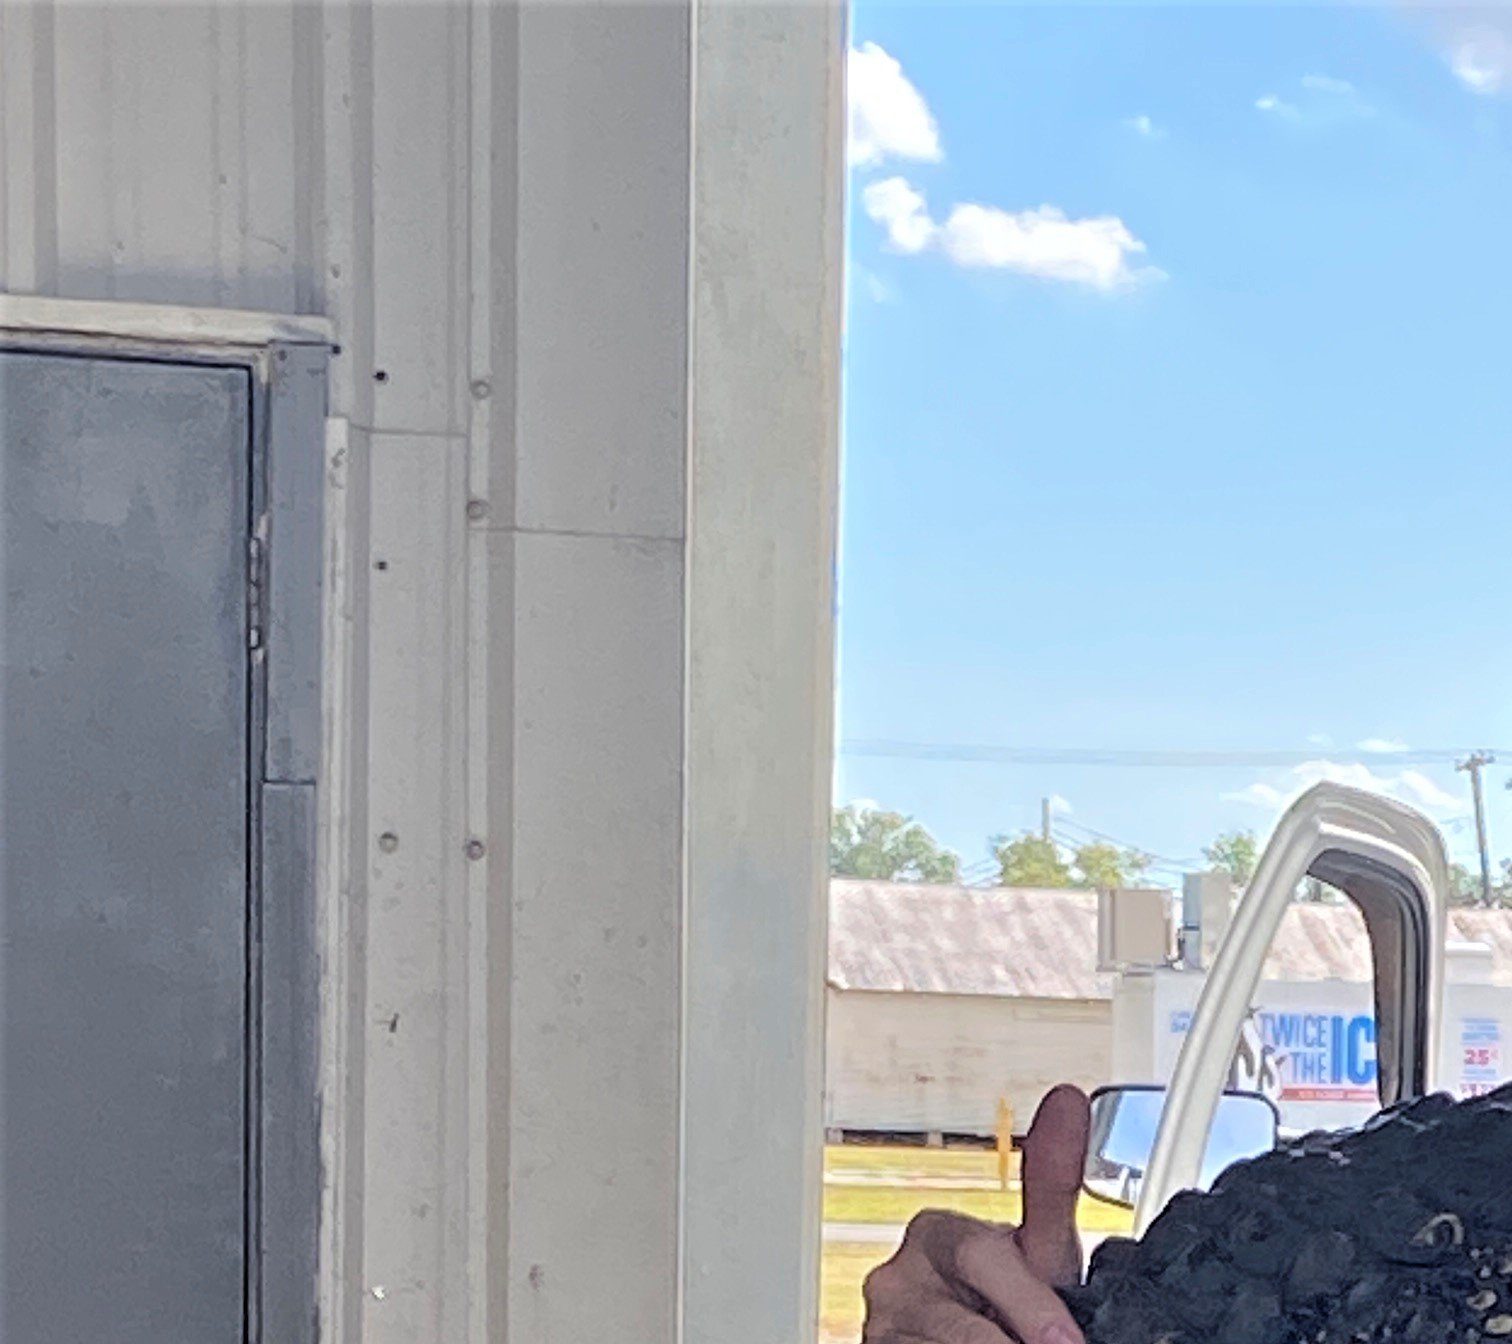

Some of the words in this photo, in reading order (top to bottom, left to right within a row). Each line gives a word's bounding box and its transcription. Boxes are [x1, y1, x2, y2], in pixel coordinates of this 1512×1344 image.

[1259, 1014, 1328, 1047] TWICE
[1331, 1015, 1377, 1084] IC
[1289, 1051, 1327, 1083] THE
